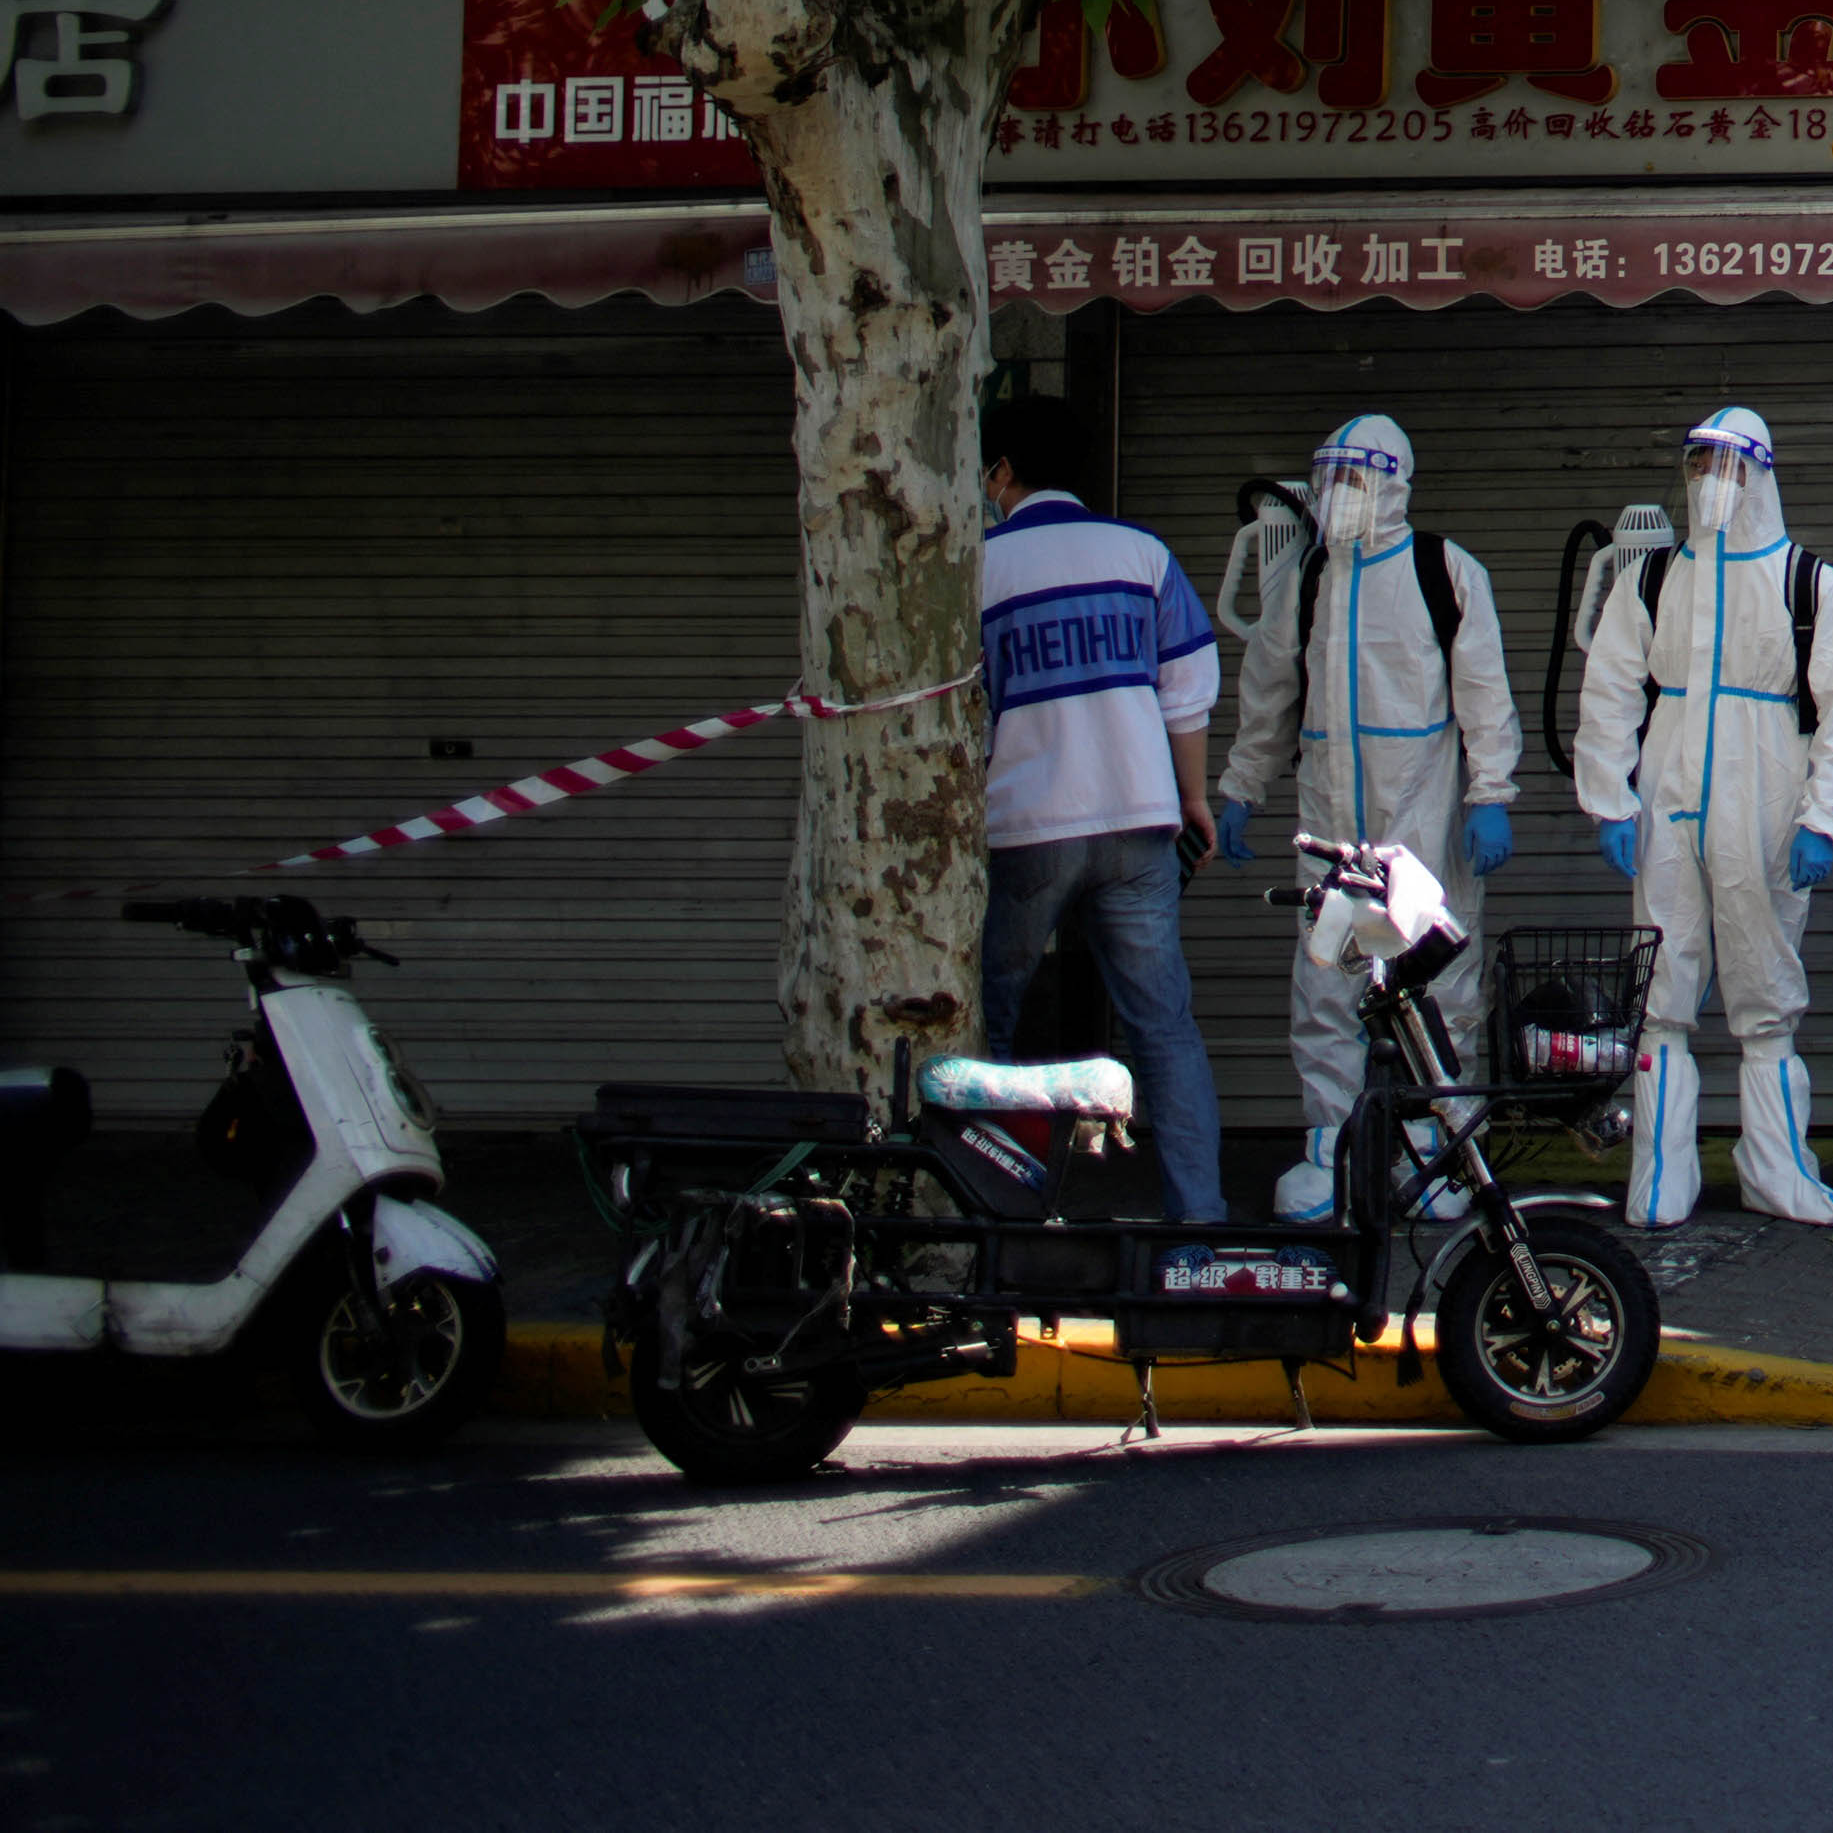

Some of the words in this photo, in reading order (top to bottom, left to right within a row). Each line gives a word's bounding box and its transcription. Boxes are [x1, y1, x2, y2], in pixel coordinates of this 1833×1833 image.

[988, 237, 1094, 293] 黄金
[1237, 233, 1343, 287] 回收
[1360, 231, 1464, 284] 加工
